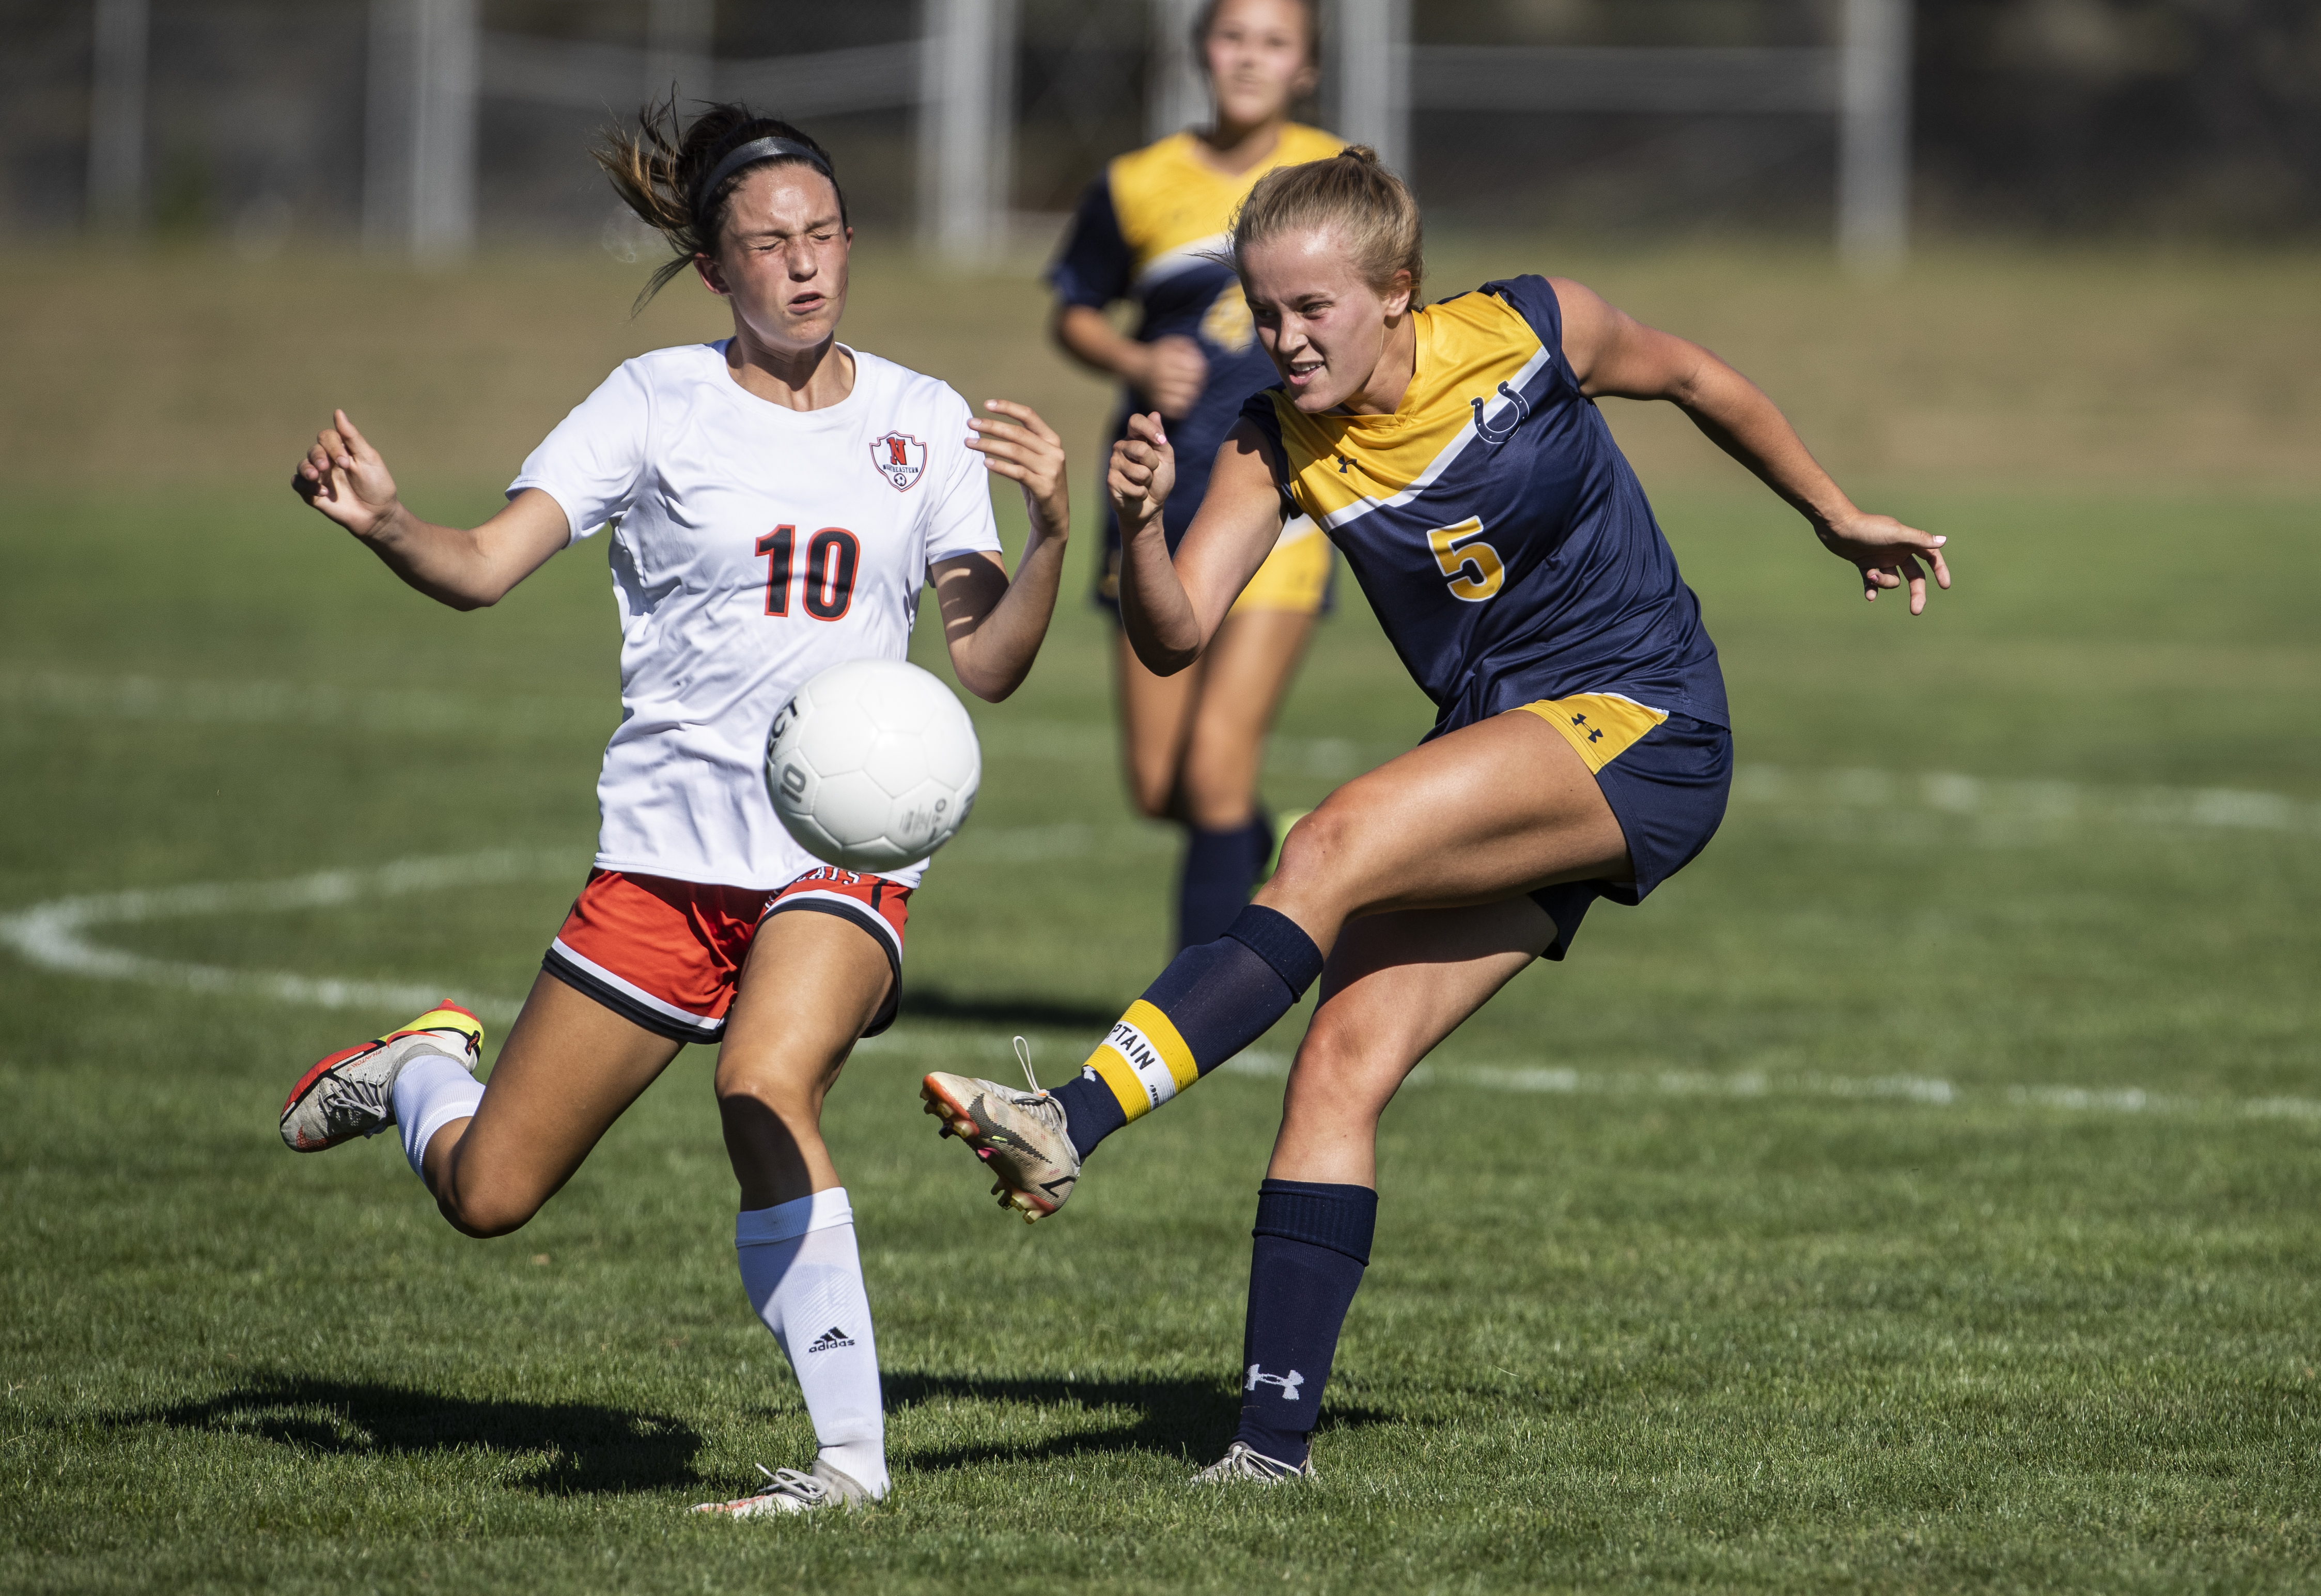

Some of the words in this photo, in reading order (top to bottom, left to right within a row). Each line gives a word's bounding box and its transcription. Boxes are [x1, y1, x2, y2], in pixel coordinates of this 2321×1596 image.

[886, 436, 907, 465] N
[754, 523, 861, 622] 10
[1426, 515, 1505, 602] 5
[780, 762, 806, 803] 10
[351, 1049, 382, 1068] PHANTOM
[808, 1339, 855, 1353] adidas
